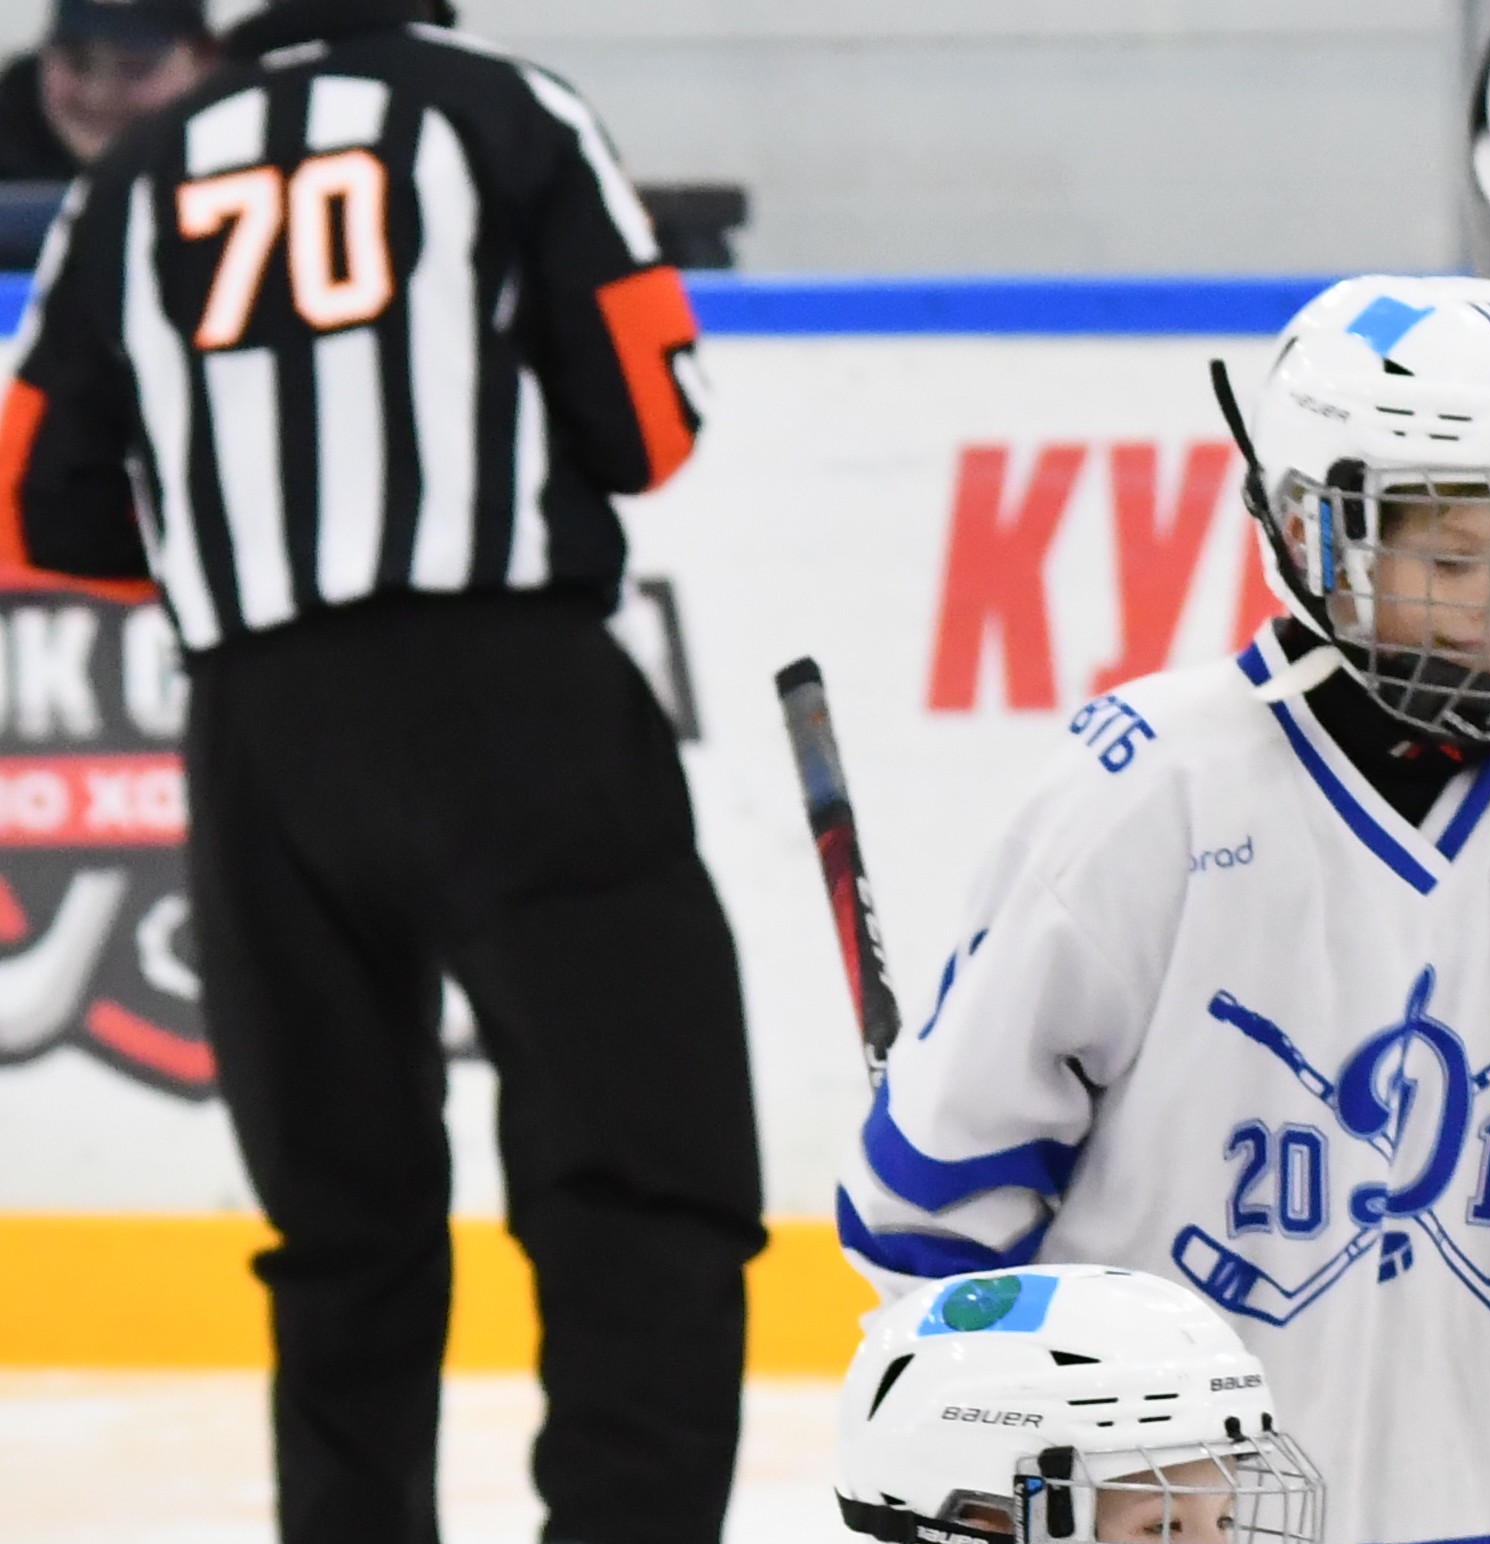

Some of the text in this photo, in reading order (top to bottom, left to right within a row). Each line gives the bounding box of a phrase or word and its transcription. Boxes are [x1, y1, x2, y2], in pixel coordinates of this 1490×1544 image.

[176, 148, 393, 349] 70
[1223, 1116, 1329, 1242] 20
[940, 1404, 1044, 1429] BAUER
